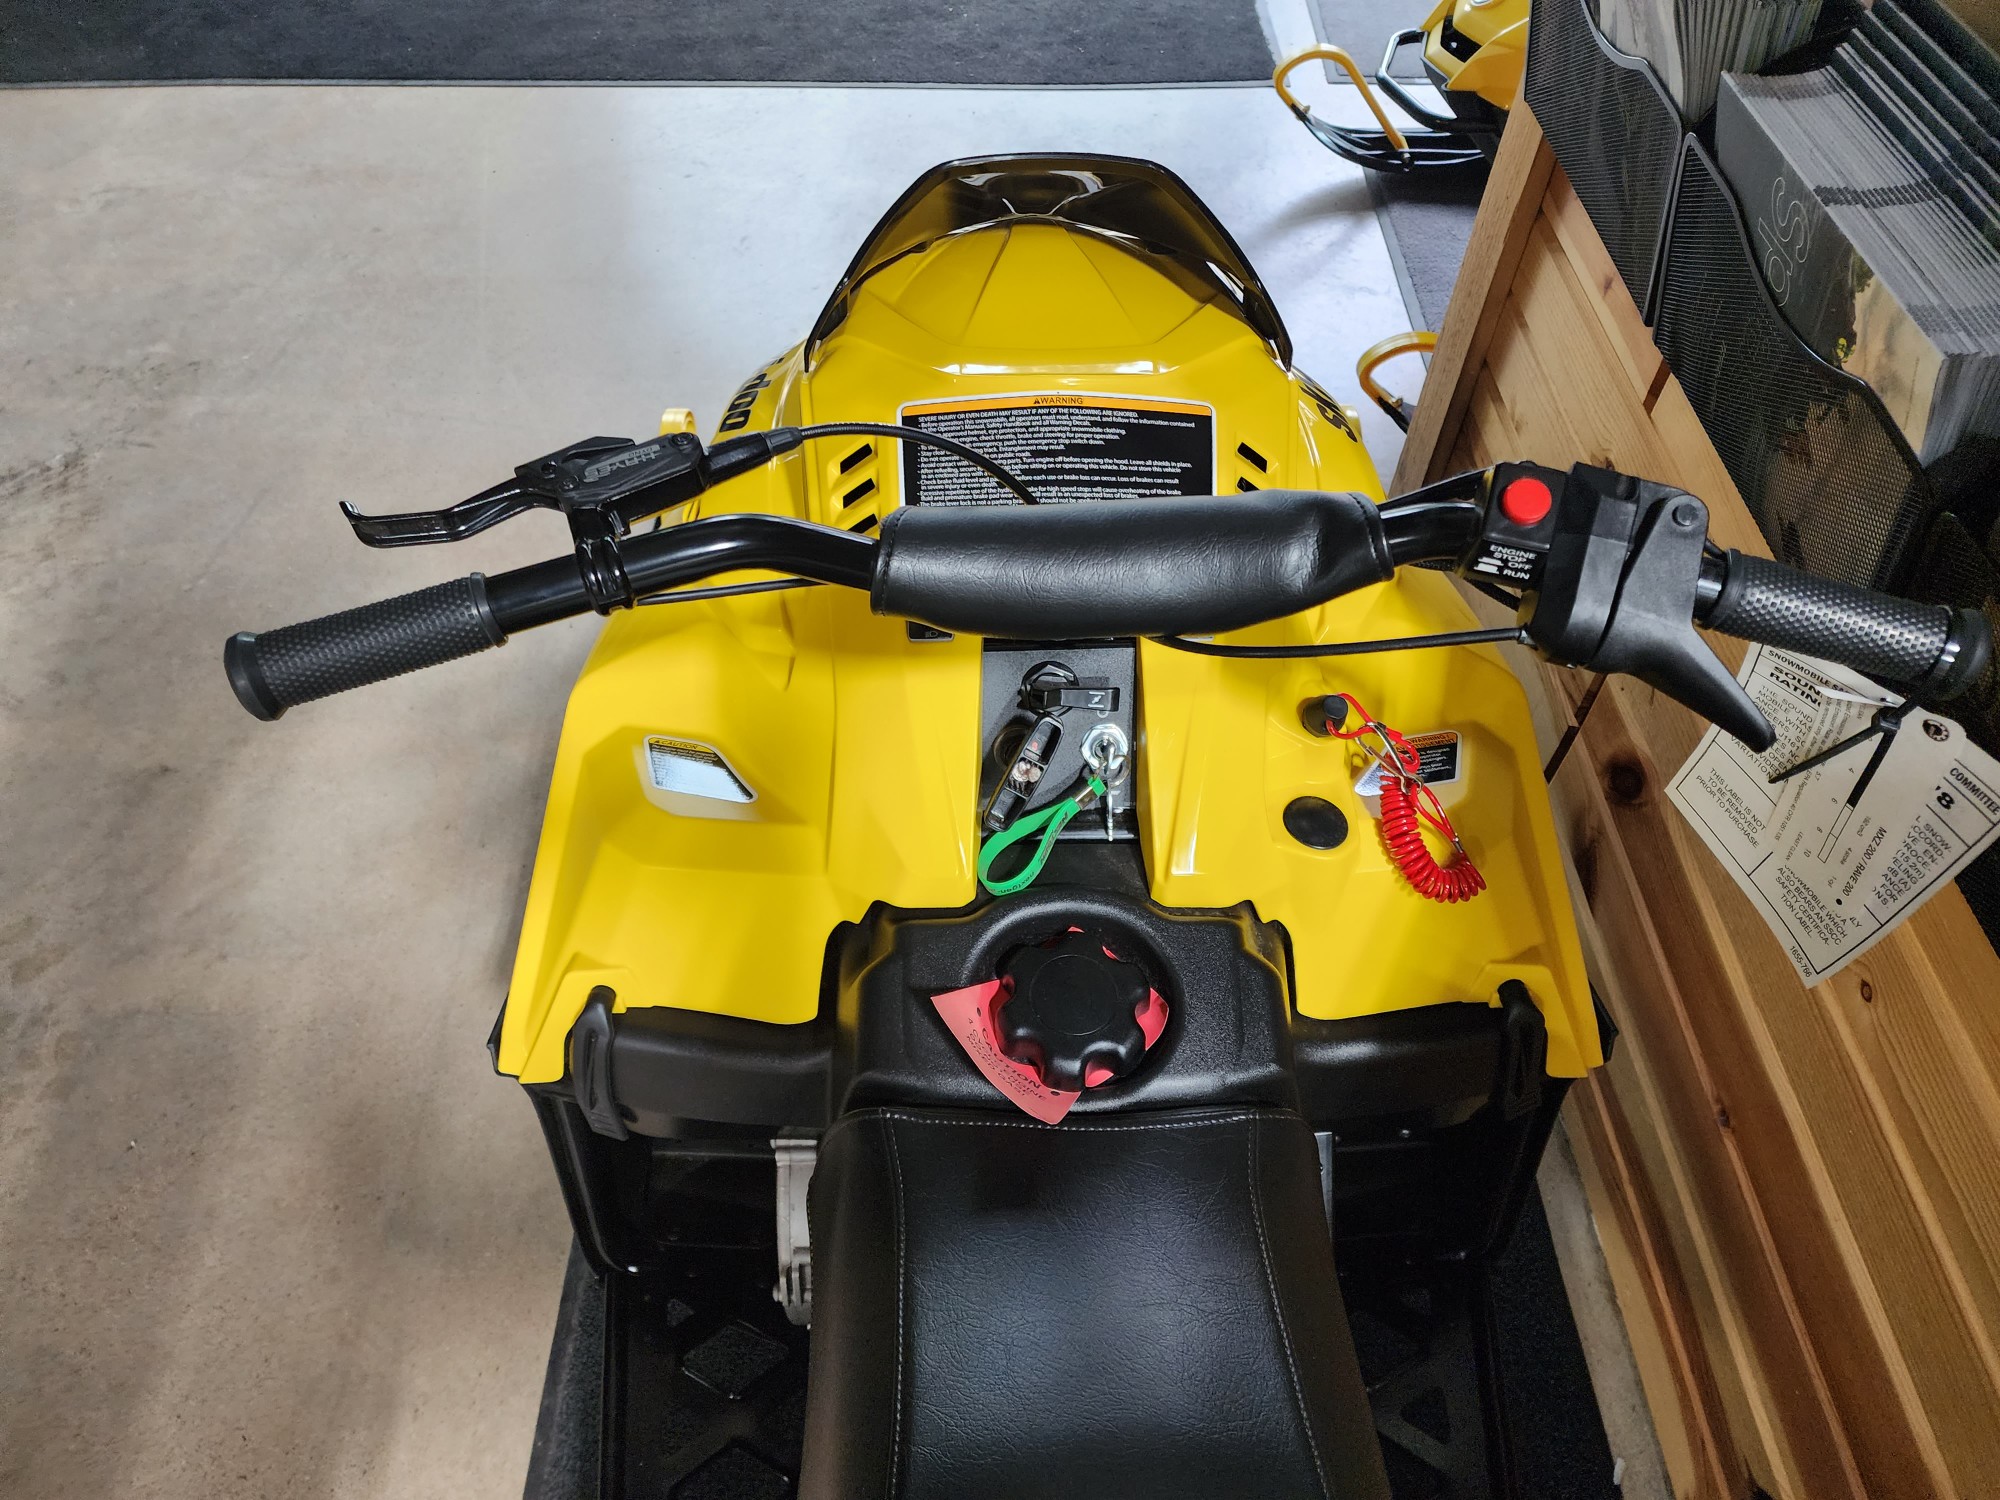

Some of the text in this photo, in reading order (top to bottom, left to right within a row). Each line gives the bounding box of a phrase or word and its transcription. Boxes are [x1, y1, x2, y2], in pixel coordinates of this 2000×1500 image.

[1113, 410, 1138, 418] IGNORED.
[1490, 544, 1537, 560] ENGINE
[1493, 552, 1527, 562] STOP
[1508, 562, 1532, 570] OFF
[1503, 569, 1530, 579] RUN
[1768, 650, 1831, 685] SNOWMOBILE
[1770, 672, 1822, 707] RATIN
[1774, 667, 1821, 698] SOUN
[1756, 696, 1805, 736] ANCE WITH
[1758, 690, 1812, 732] MOBILE HAS
[1762, 686, 1813, 723] THE SOUND
[661, 740, 698, 749] CAUTION
[1779, 732, 1799, 751] J1161
[1707, 777, 1758, 834] TO BE REMOVED
[1710, 768, 1766, 831] THIS LABEL IS NOT
[1949, 767, 2000, 816] COMMITTEE
[1696, 775, 1758, 848] PRIOR TO PURCHASE
[1871, 826, 1887, 846] MXZ
[1863, 844, 1877, 860] 200
[1849, 862, 1866, 884] RAVE
[1841, 881, 1854, 896] 200
[1880, 883, 1898, 903] FOR
[1775, 876, 1831, 946] SAFETY CERTIFICA-
[1777, 867, 1842, 945] ALSO BEARS AN SSCC
[1781, 894, 1796, 912] TION
[1825, 912, 1847, 938] WHICH
[1789, 946, 1812, 978] 1655-766
[981, 1027, 1042, 1089] CAUTION
